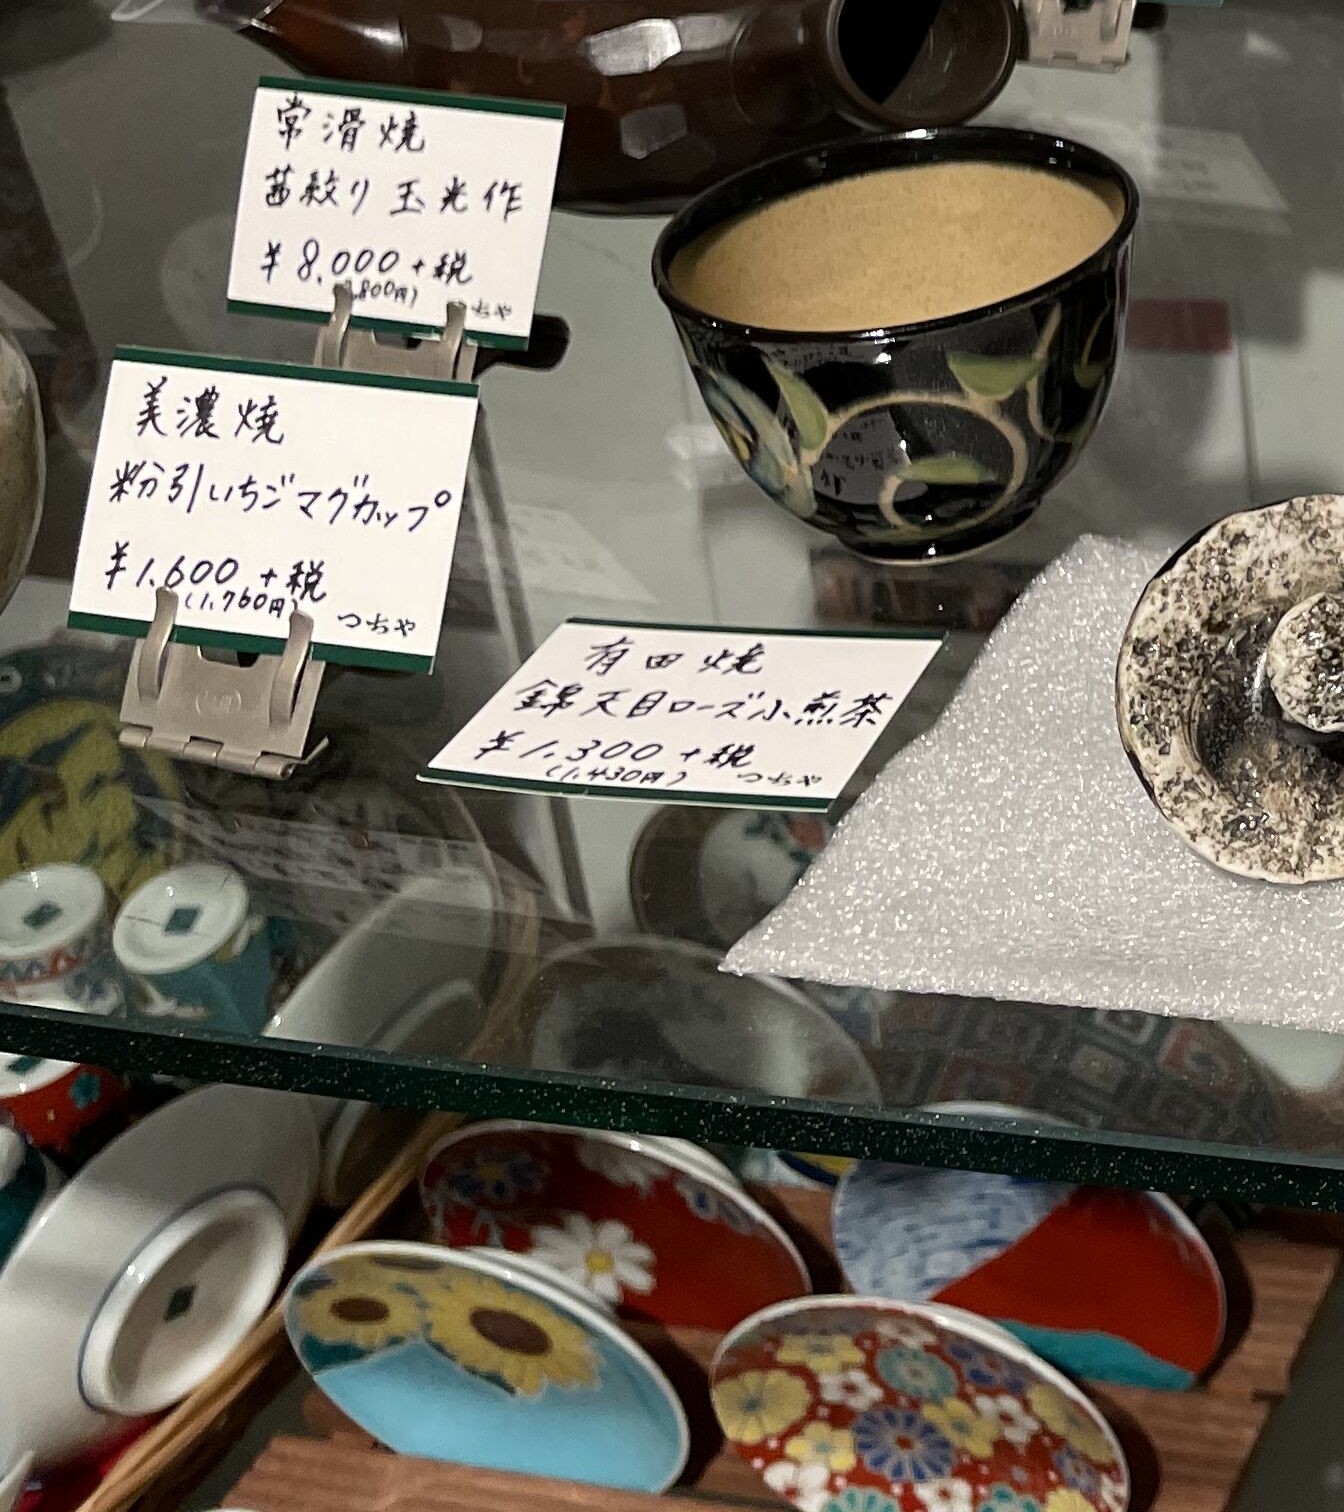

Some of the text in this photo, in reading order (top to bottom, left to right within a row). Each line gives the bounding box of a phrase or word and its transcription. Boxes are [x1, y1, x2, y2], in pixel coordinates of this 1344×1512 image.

[276, 95, 426, 153] 常滑焼
[470, 297, 513, 322] ちや
[136, 376, 285, 445] 美濃焼
[337, 612, 417, 638] つちや
[583, 635, 766, 676] 有田焼
[736, 770, 824, 789] つちや
